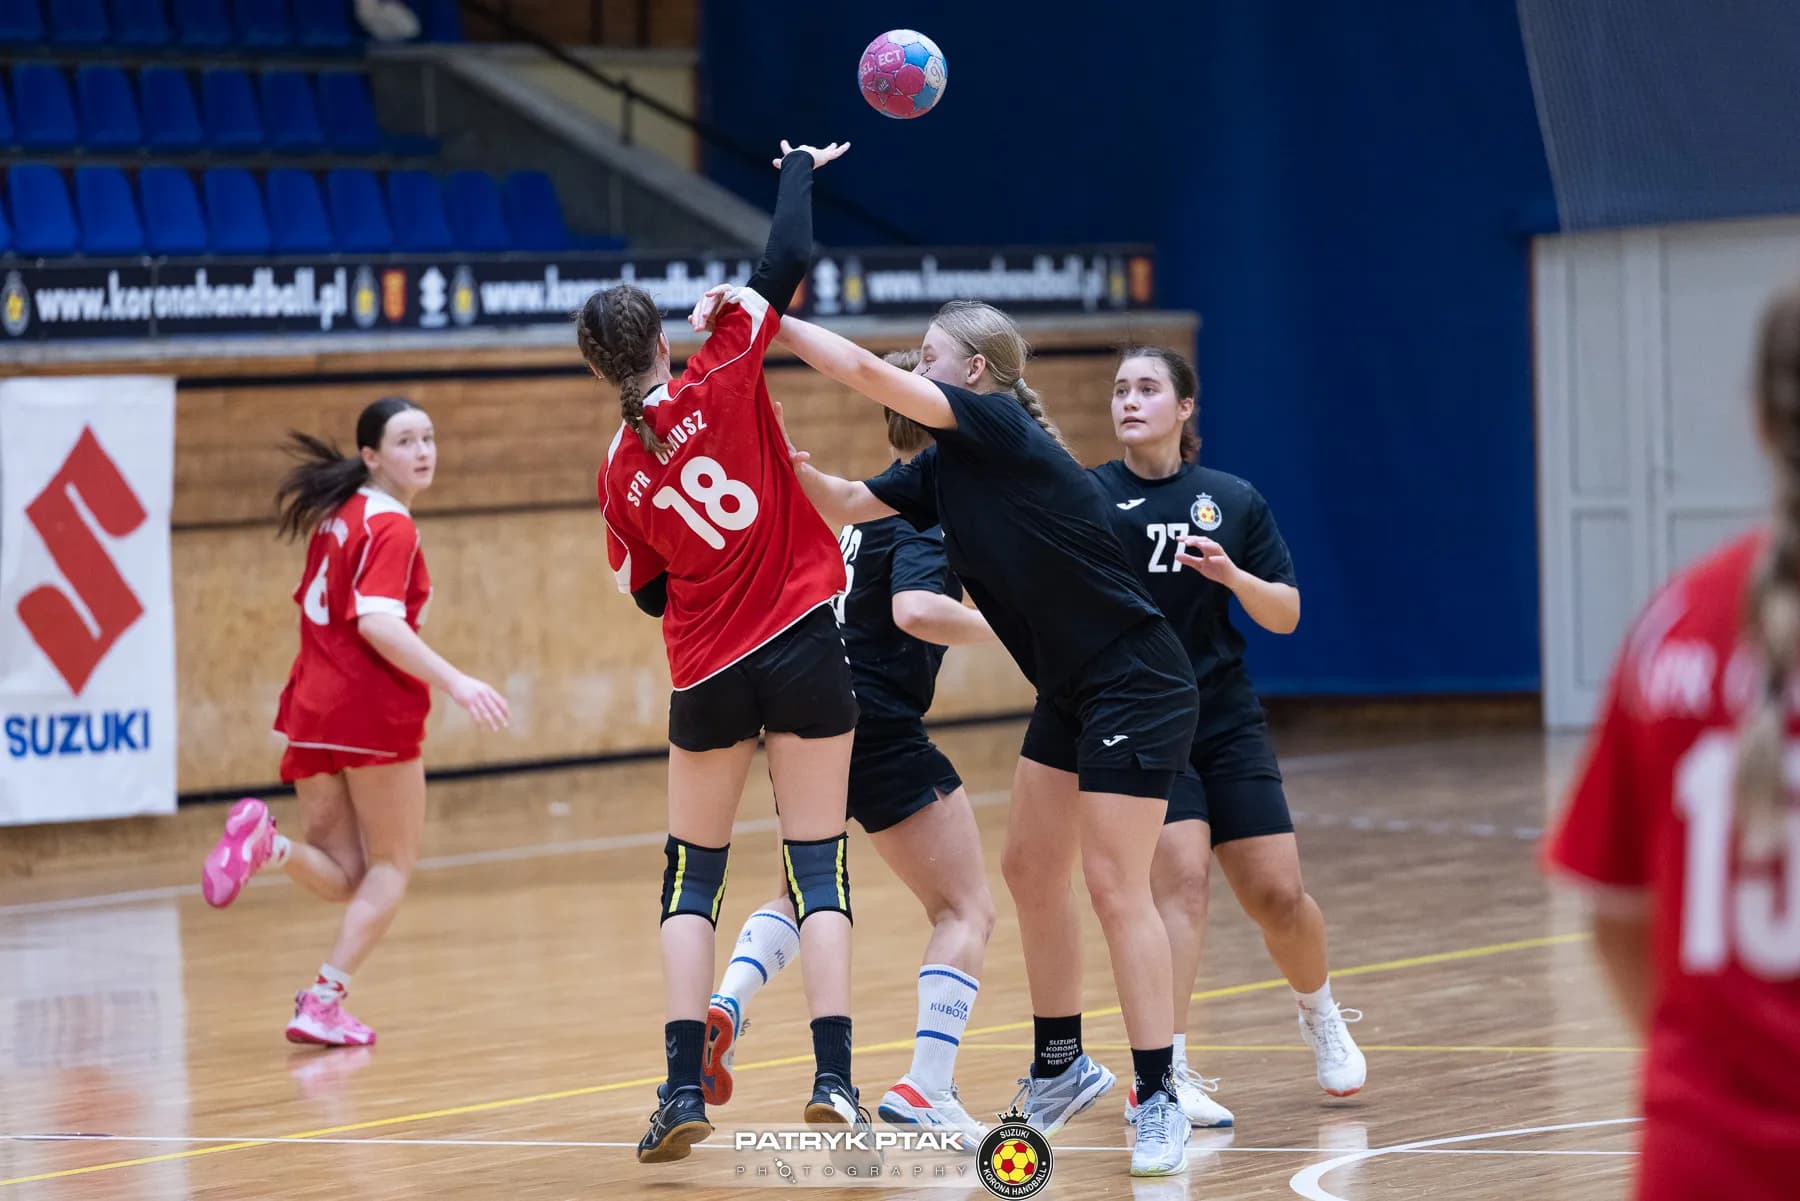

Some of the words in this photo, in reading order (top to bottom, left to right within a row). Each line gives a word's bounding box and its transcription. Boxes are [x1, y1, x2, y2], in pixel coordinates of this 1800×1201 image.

[627, 470, 652, 508] SPR
[652, 455, 759, 550] 18
[1146, 523, 1190, 573] 27
[5, 708, 151, 758] SUZUKI
[930, 1002, 967, 1021] KUBOTA
